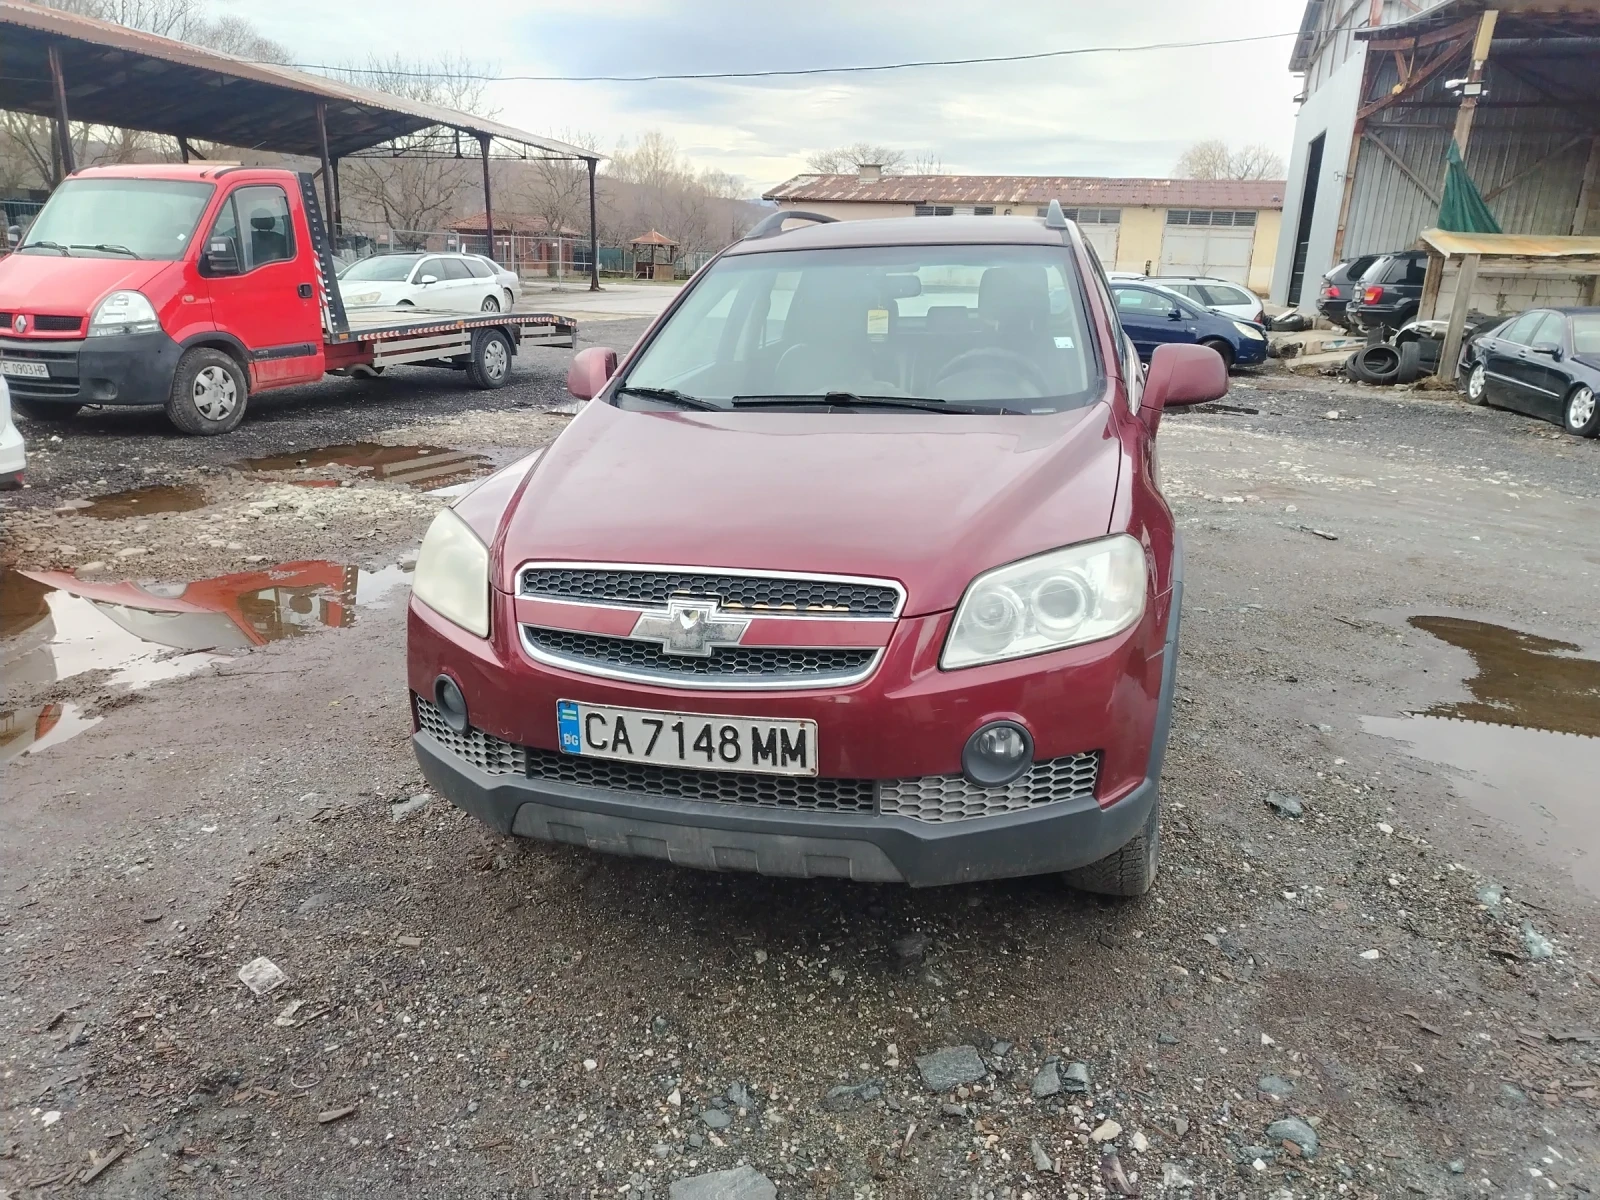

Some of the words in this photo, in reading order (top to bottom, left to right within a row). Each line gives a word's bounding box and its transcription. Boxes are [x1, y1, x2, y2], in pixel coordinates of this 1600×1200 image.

[12, 363, 33, 375] 0903
[33, 364, 46, 375] HP
[563, 733, 578, 746] BG
[585, 712, 633, 755] CA
[641, 718, 742, 763] 7148
[751, 726, 807, 768] MM
